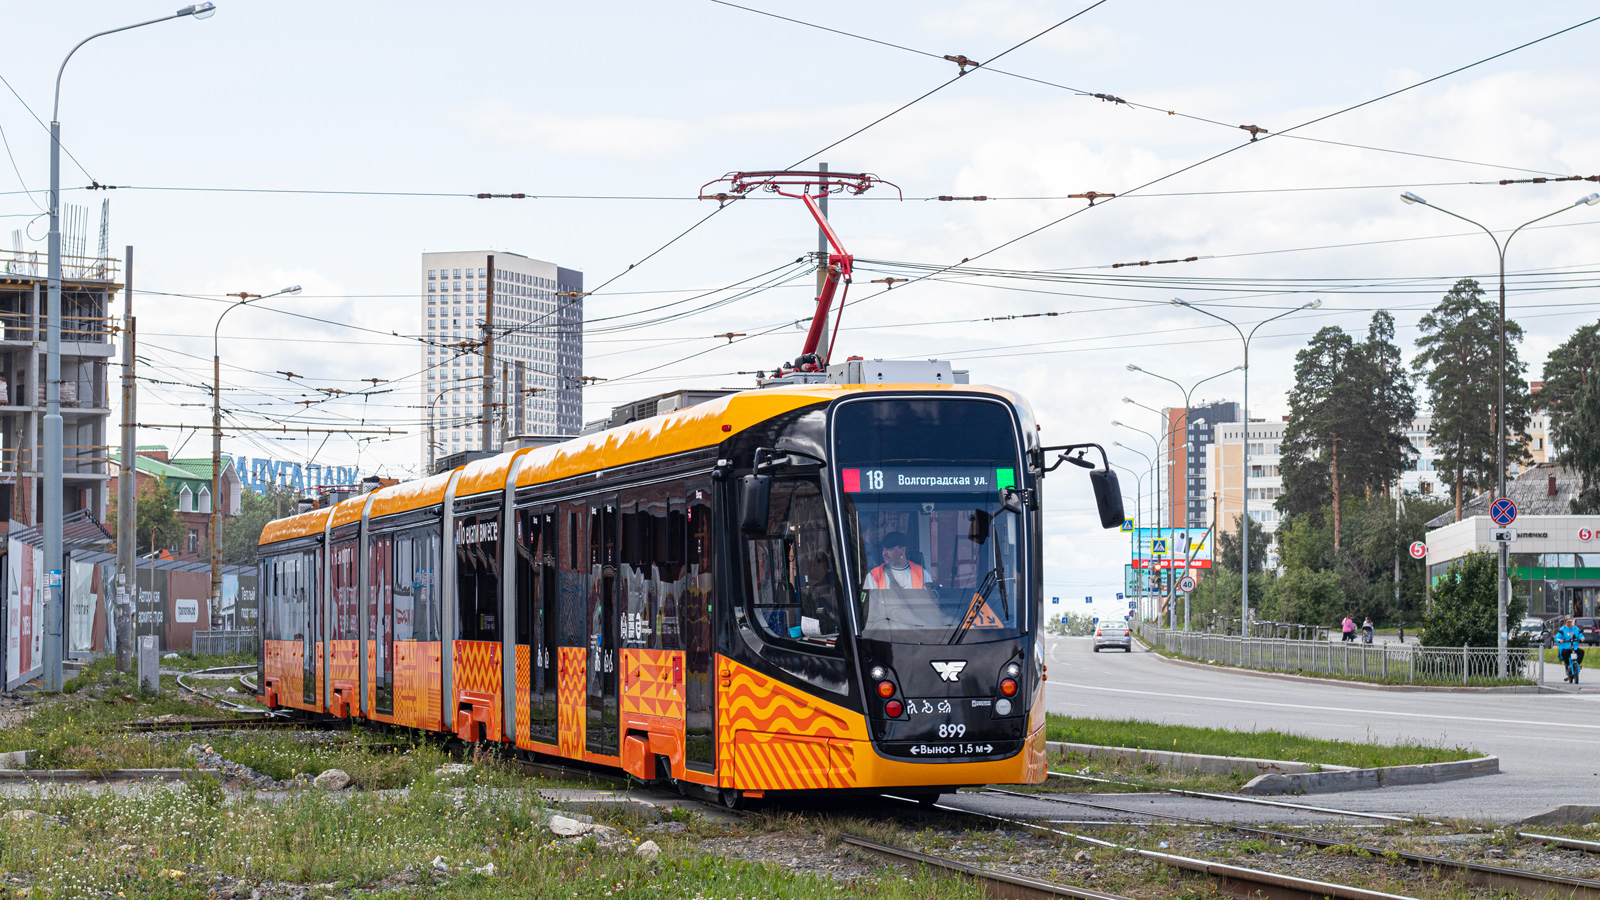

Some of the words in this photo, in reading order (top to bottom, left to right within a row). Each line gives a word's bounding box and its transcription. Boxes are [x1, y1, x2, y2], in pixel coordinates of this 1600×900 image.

[866, 470, 884, 490] 18
[898, 474, 970, 486] Волгоградская
[974, 476, 988, 486] ул.
[1517, 531, 1548, 539] ыпечка
[1183, 581, 1193, 589] 40
[138, 587, 160, 606] Авторкая
[938, 723, 966, 738] 899
[920, 744, 956, 754] Вынос
[959, 744, 974, 754] 1,5
[975, 745, 984, 753] м
